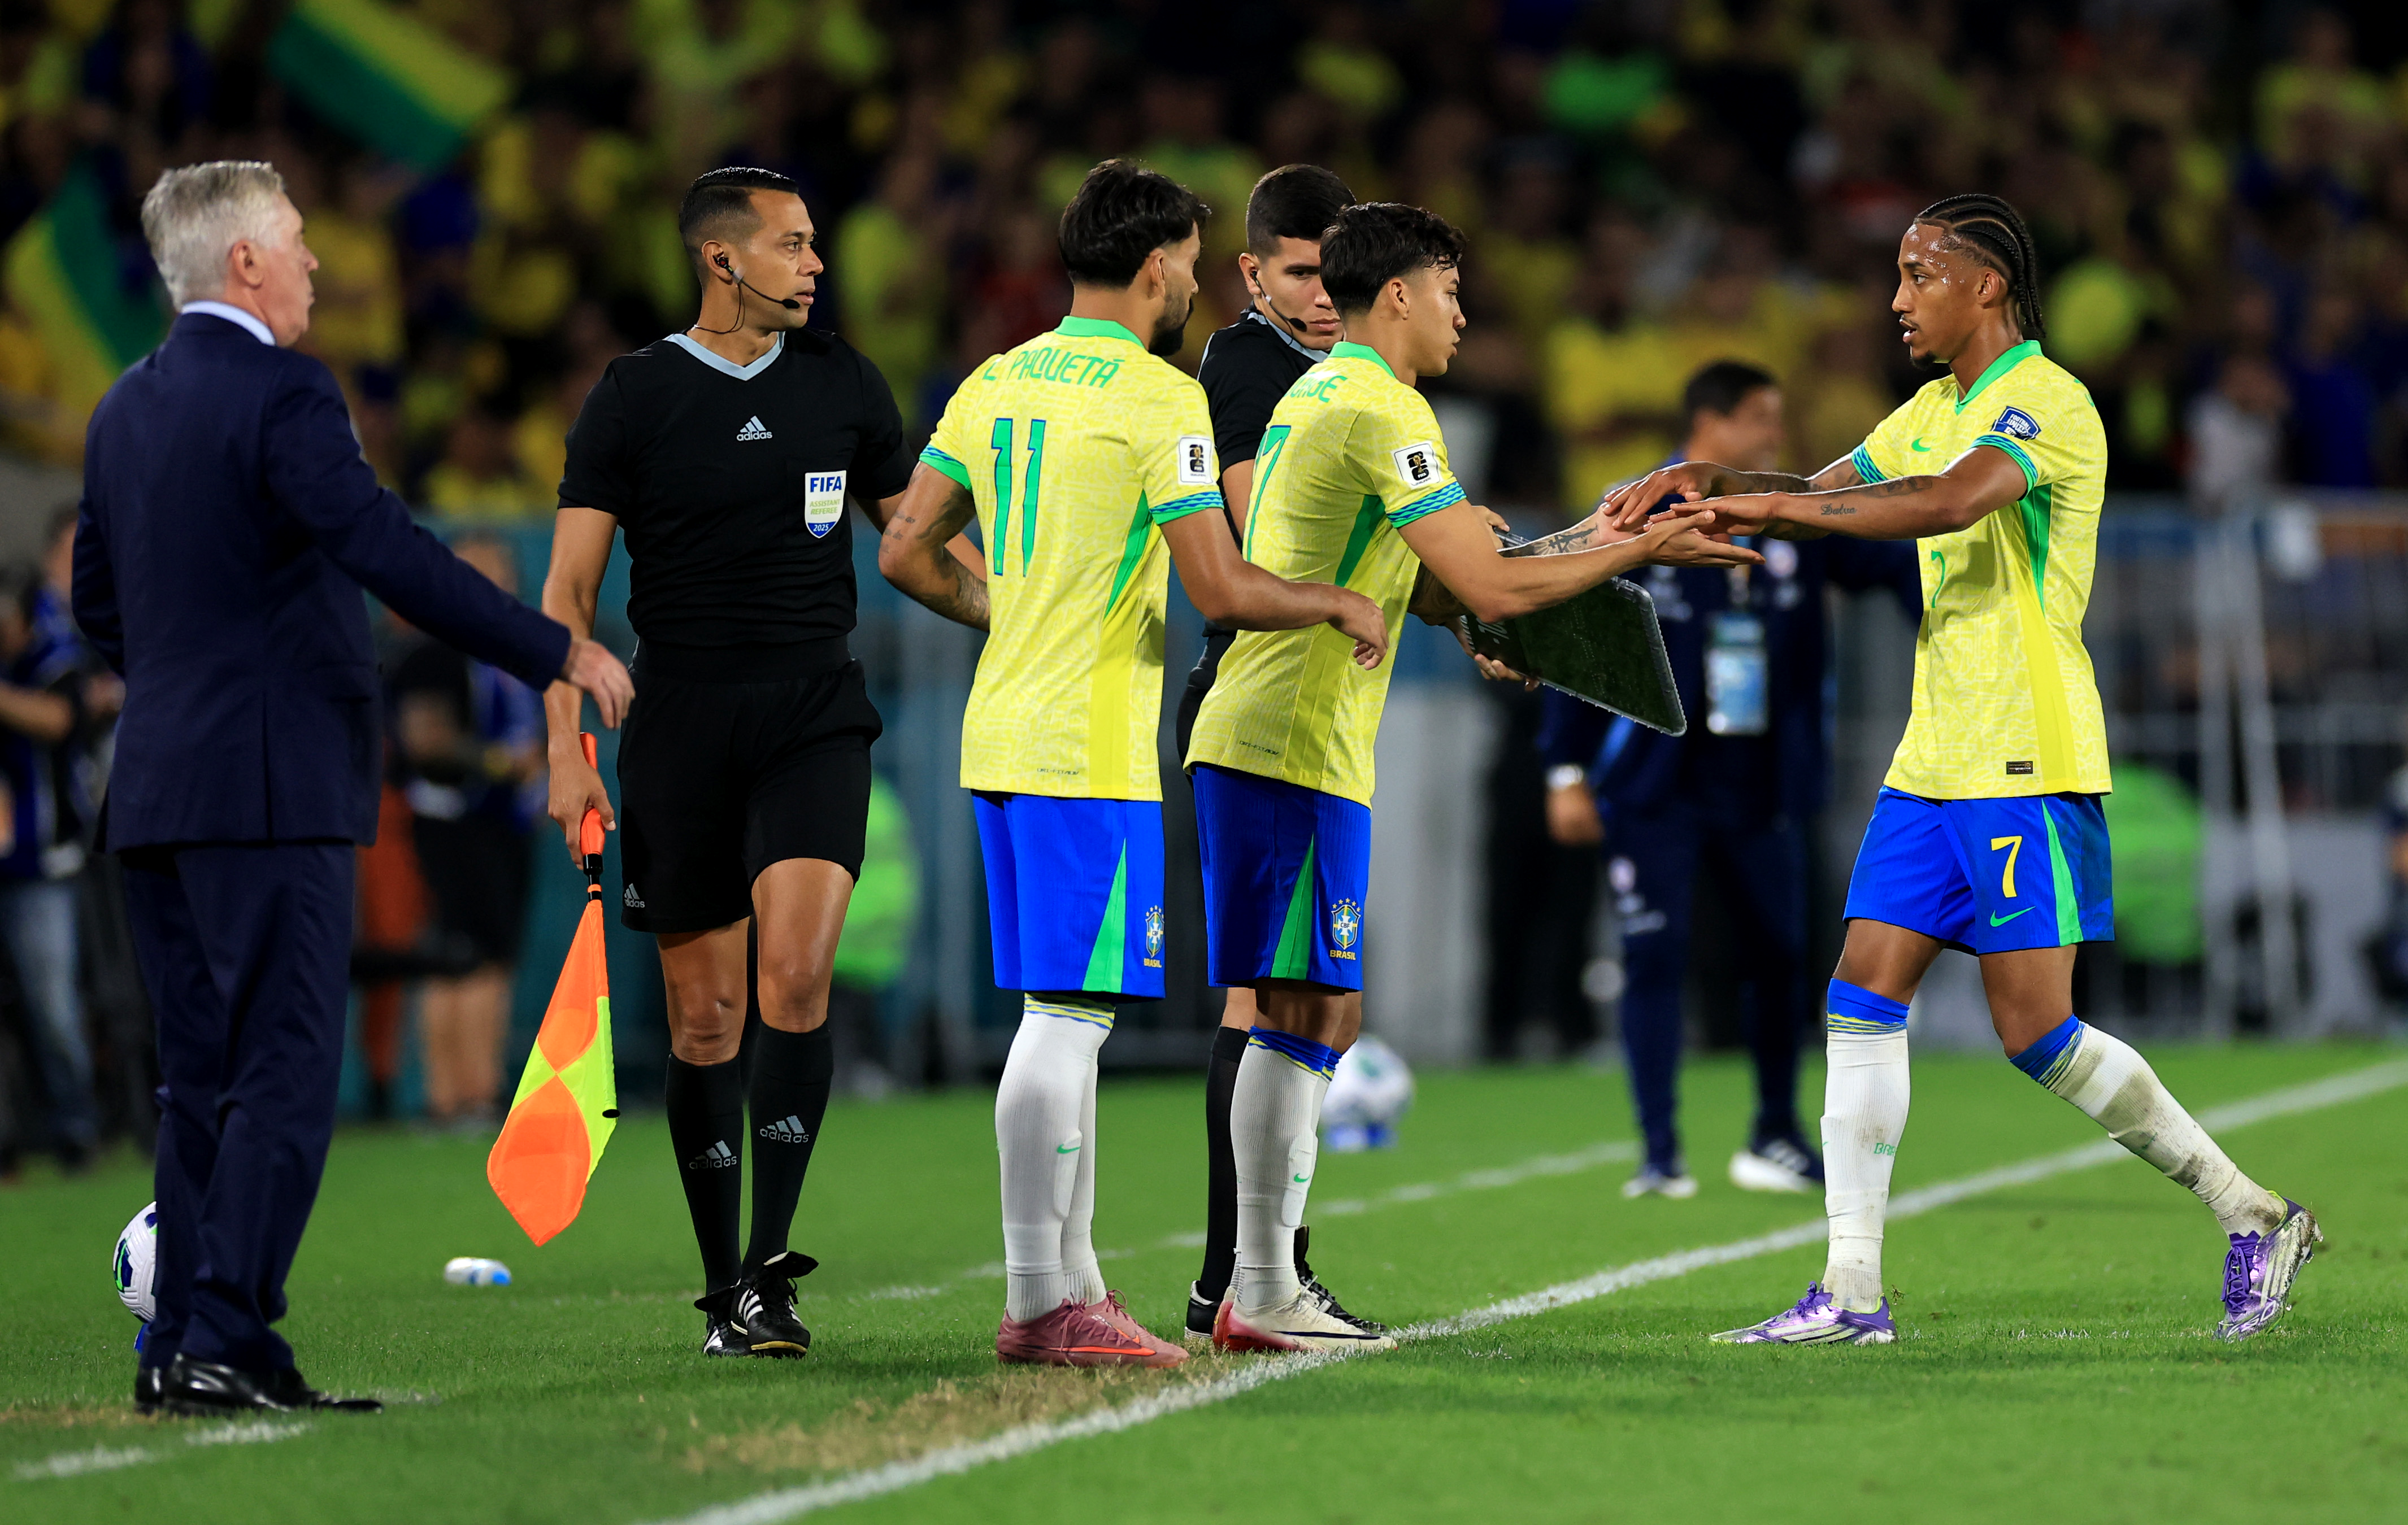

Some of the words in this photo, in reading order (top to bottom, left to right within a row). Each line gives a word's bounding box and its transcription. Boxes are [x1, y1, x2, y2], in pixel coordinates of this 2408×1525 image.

[1006, 347, 1126, 389] PAQUETÁ
[736, 431, 773, 441] adidas
[810, 476, 842, 493] FIFA
[809, 499, 841, 508] ASSISTANT
[991, 417, 1046, 577] 11
[813, 524, 829, 532] 2025
[1990, 835, 2023, 898] 7
[1329, 949, 1357, 961] BRASIL
[1144, 957, 1163, 968] BRASIL
[759, 1128, 810, 1143] adidas
[689, 1156, 737, 1170] adidas
